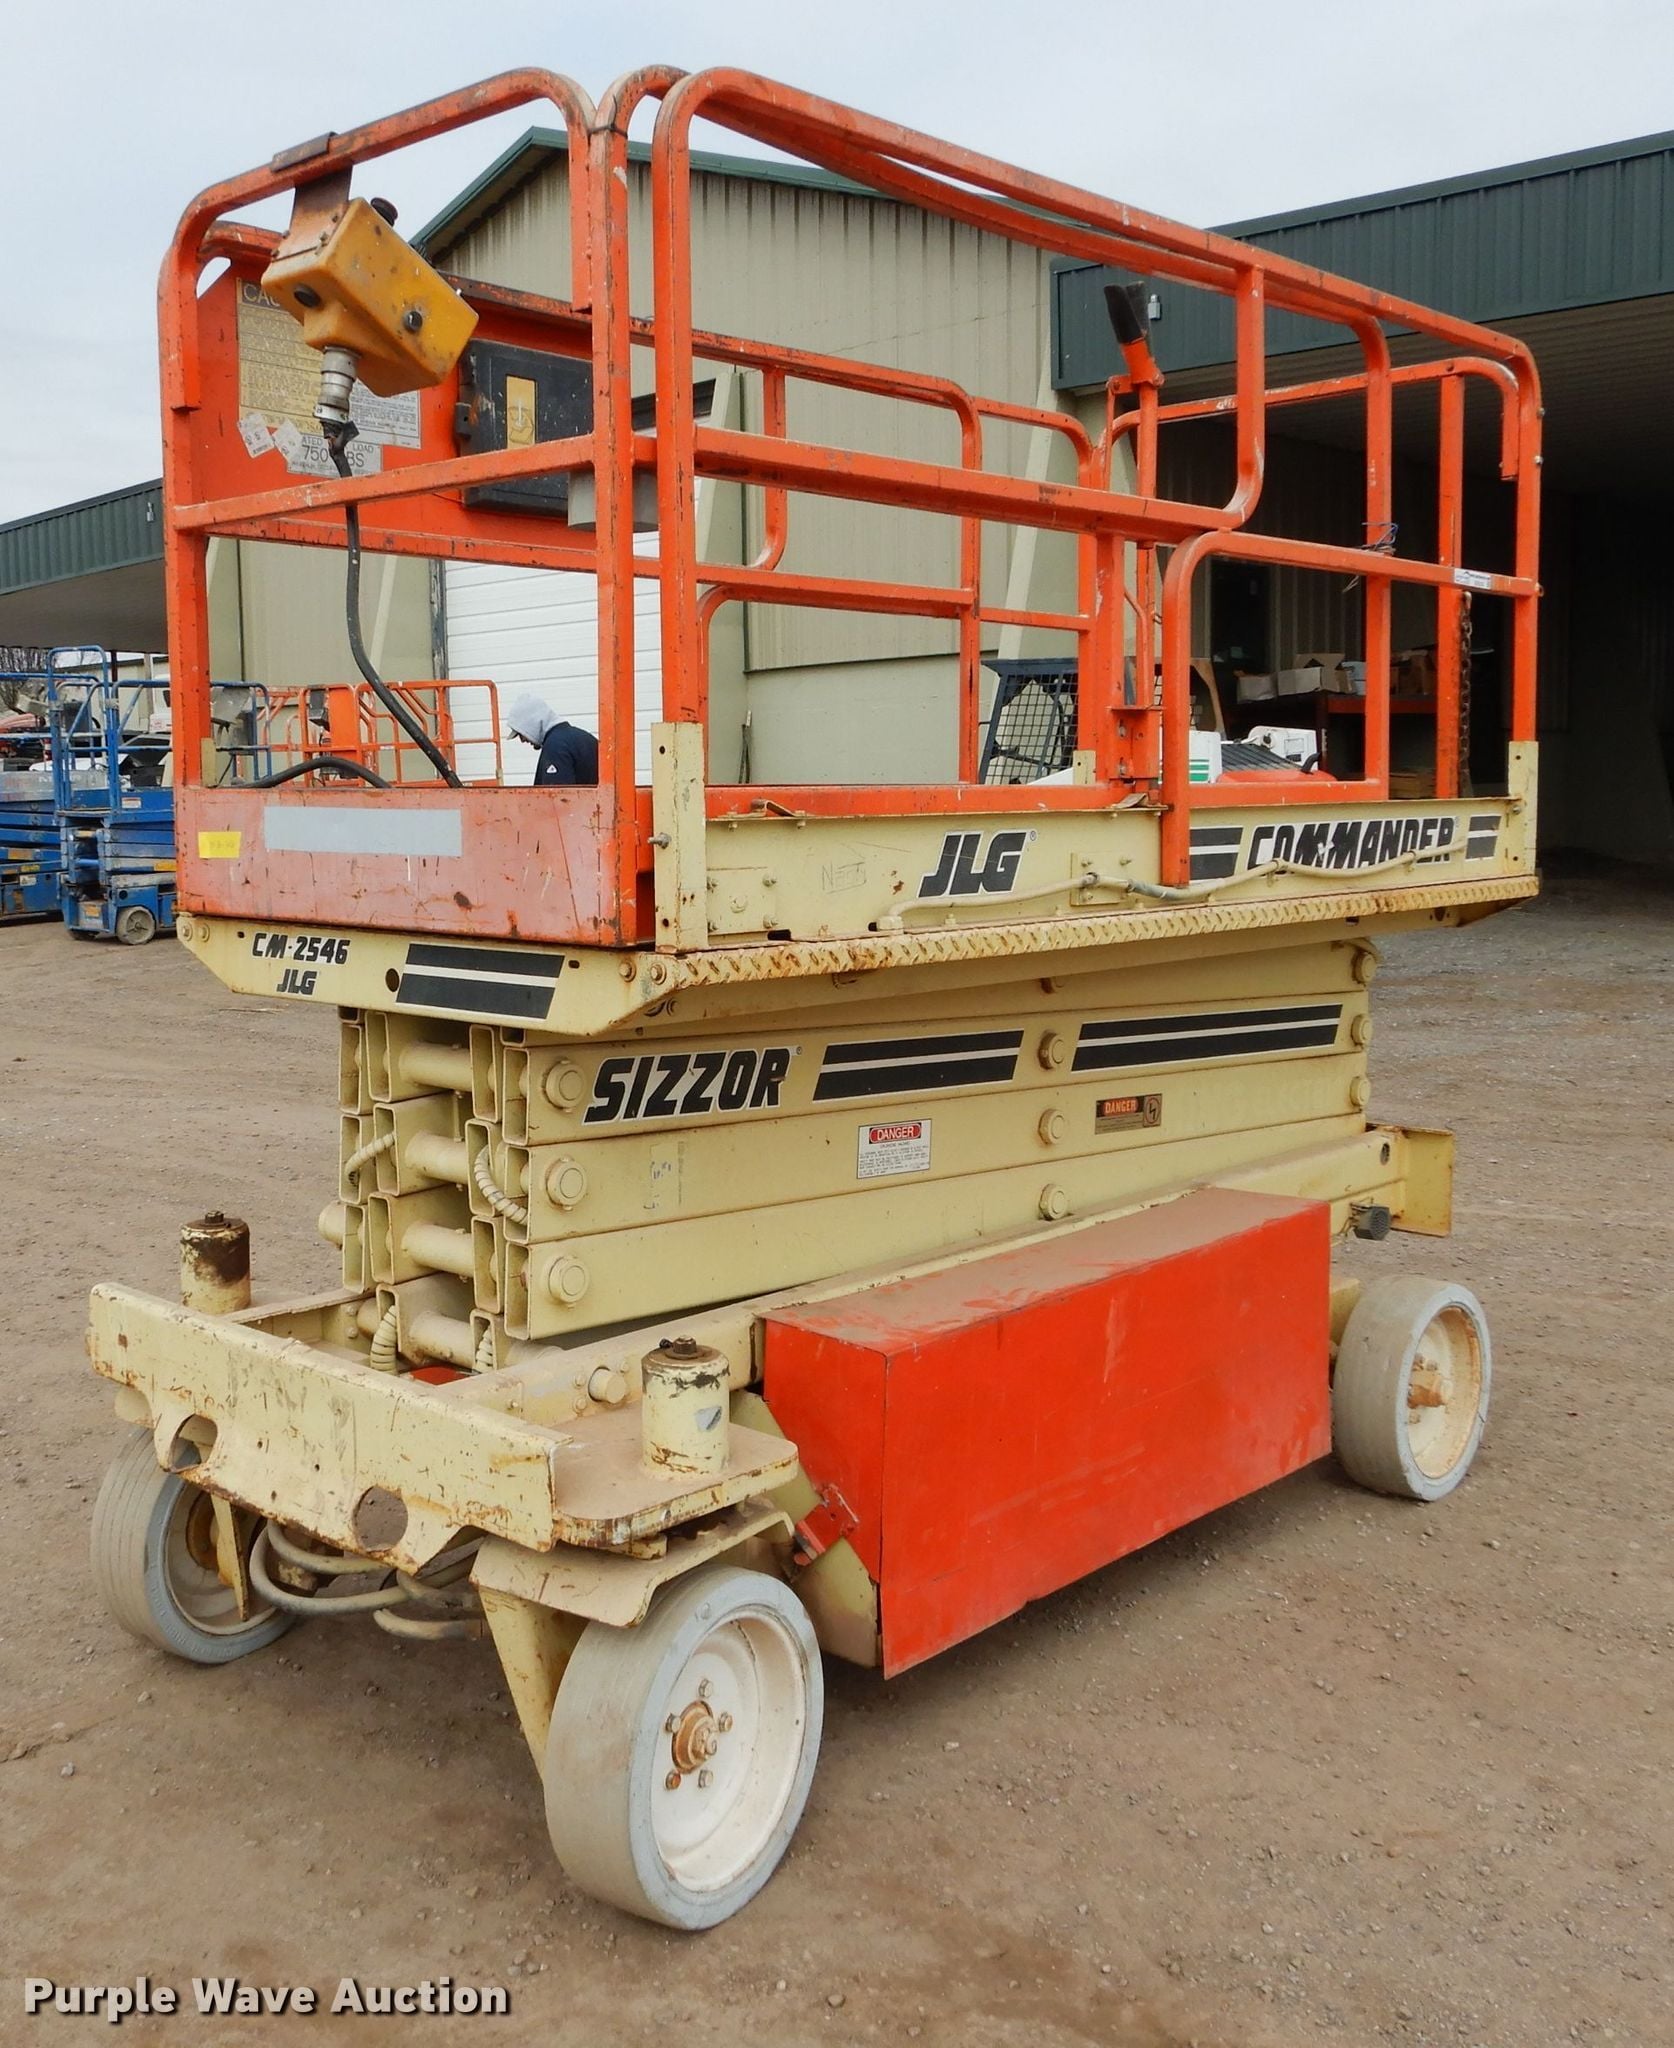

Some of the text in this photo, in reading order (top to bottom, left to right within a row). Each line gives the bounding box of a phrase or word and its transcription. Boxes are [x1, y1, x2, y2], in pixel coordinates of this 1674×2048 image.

[301, 435, 324, 446] ATED
[301, 444, 329, 463] 750
[345, 450, 365, 468] BS
[1247, 816, 1456, 876] COMMANDER
[918, 832, 1027, 898] JLG
[276, 968, 318, 996] JLG
[583, 1047, 791, 1124] SIZZOR
[1105, 1099, 1137, 1114] DANGER
[876, 1125, 915, 1141] DANGER
